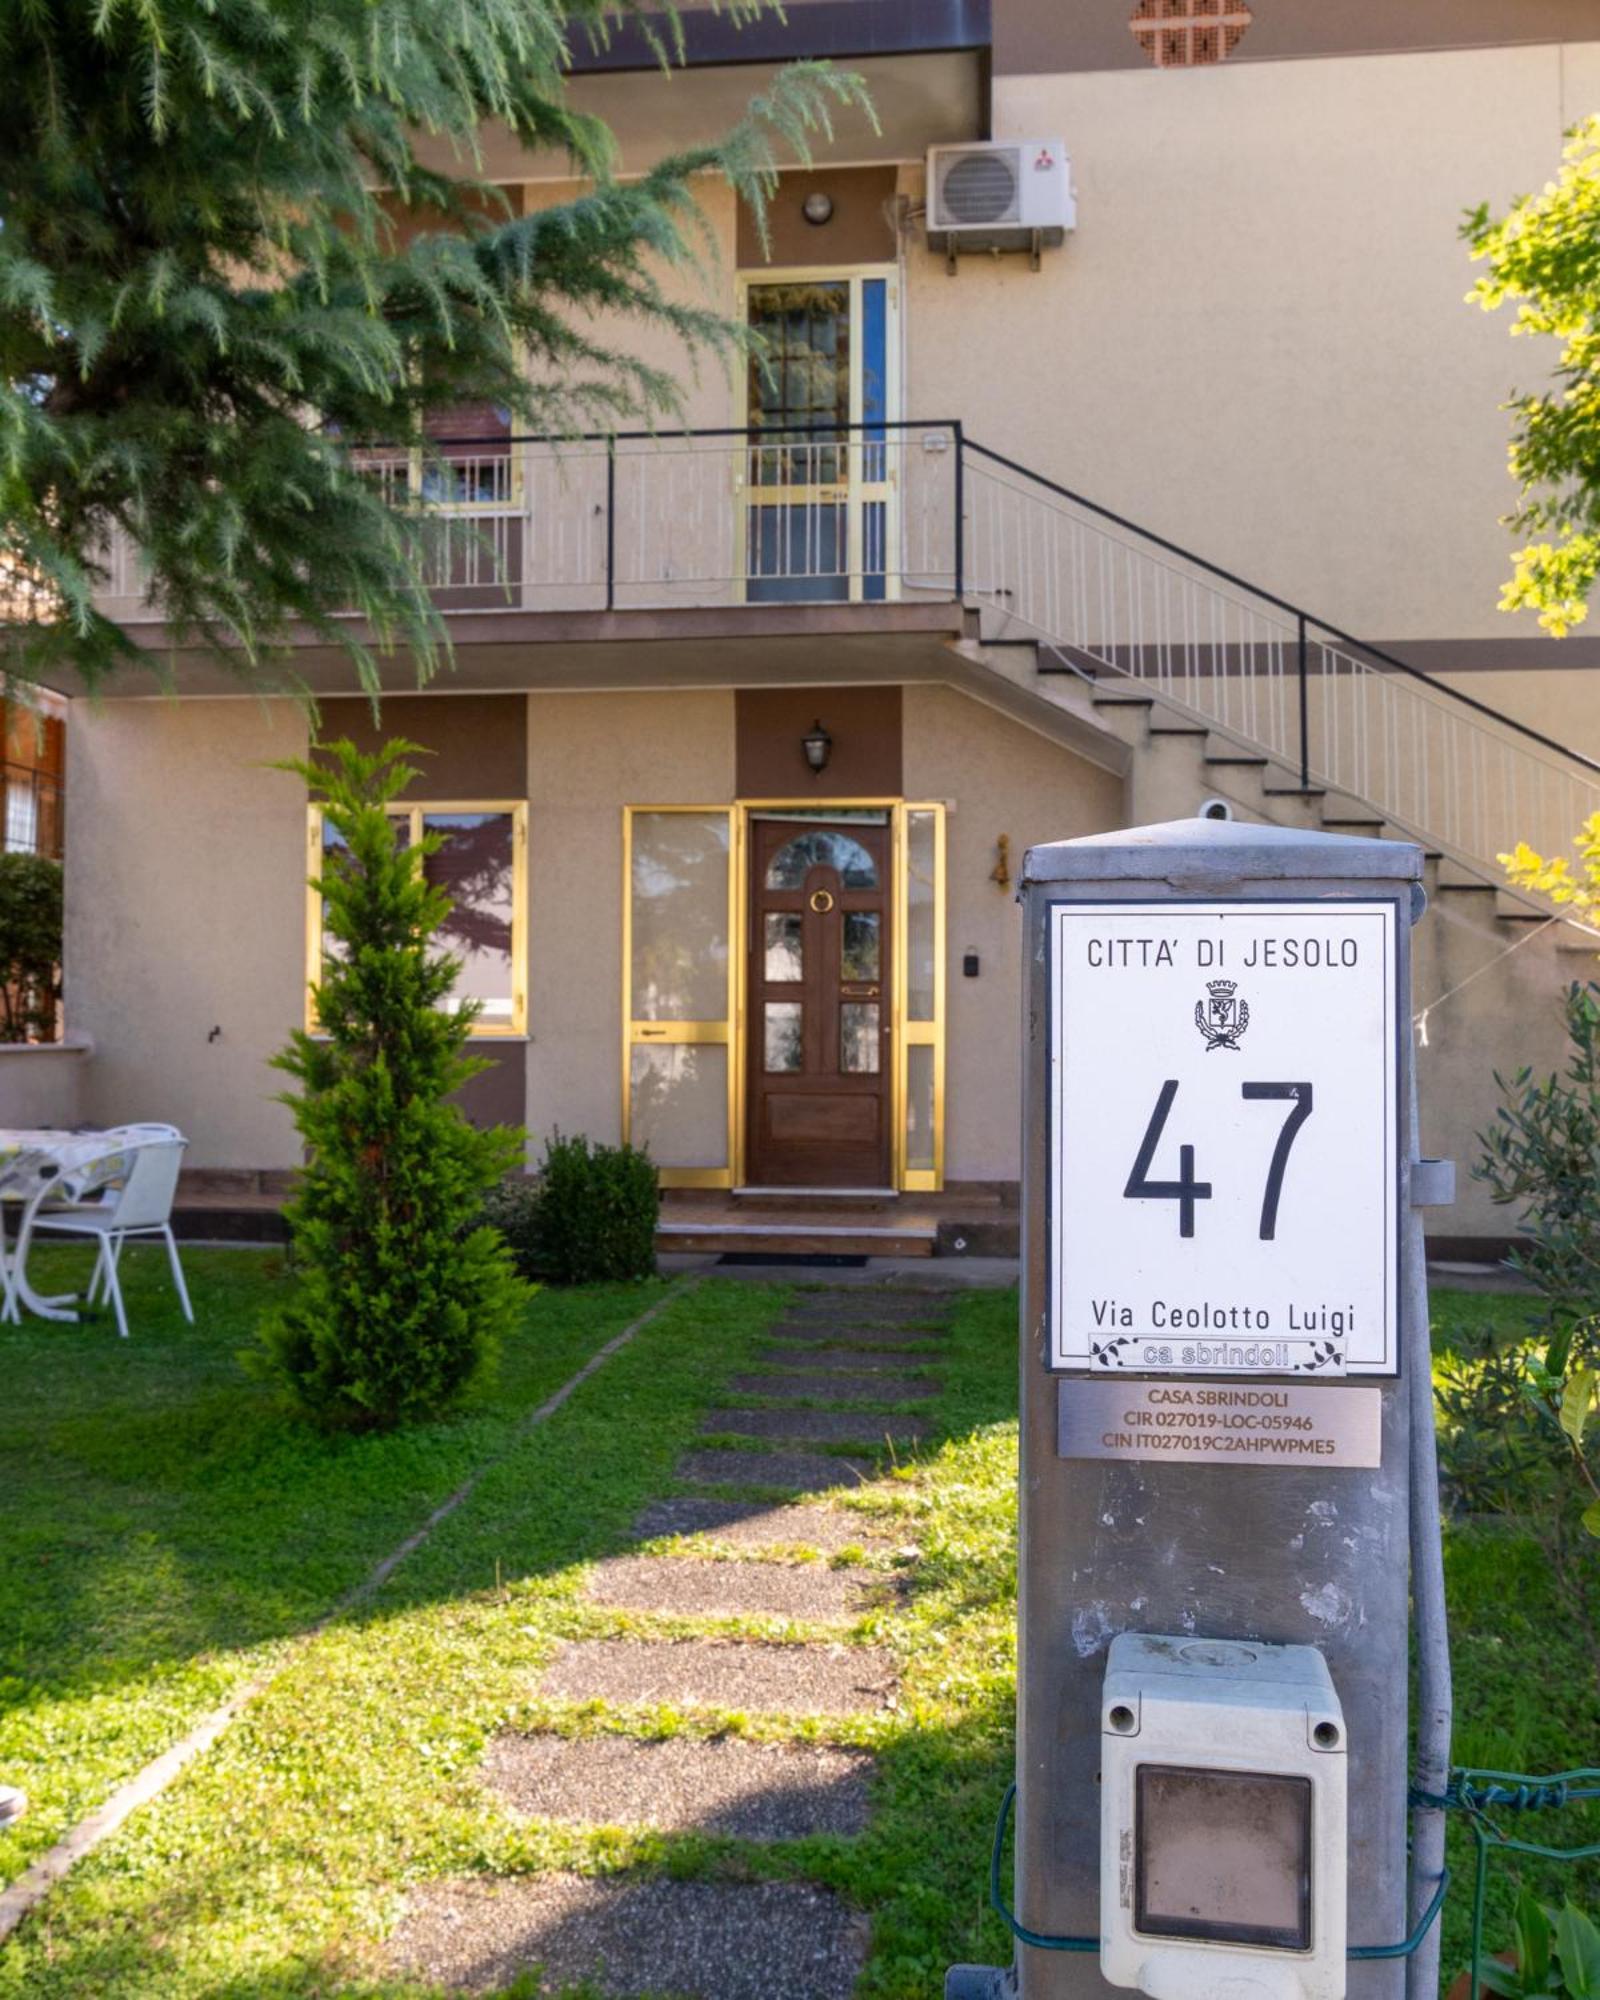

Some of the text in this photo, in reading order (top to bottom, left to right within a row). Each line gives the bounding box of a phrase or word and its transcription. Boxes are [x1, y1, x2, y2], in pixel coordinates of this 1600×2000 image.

[1087, 938, 1358, 967] CITTA' DI JESOLO
[1122, 1079, 1314, 1241] 47
[1092, 1300, 1355, 1337] Via Ceolotto Luigi
[1143, 1342, 1289, 1367] ca sbrindoli
[1148, 1389, 1288, 1408] CASA SBRINDOLI
[1123, 1411, 1313, 1431] CIR 027019-LOC-05946
[1102, 1433, 1335, 1454] CIN IT027019C2AHPWPME5
